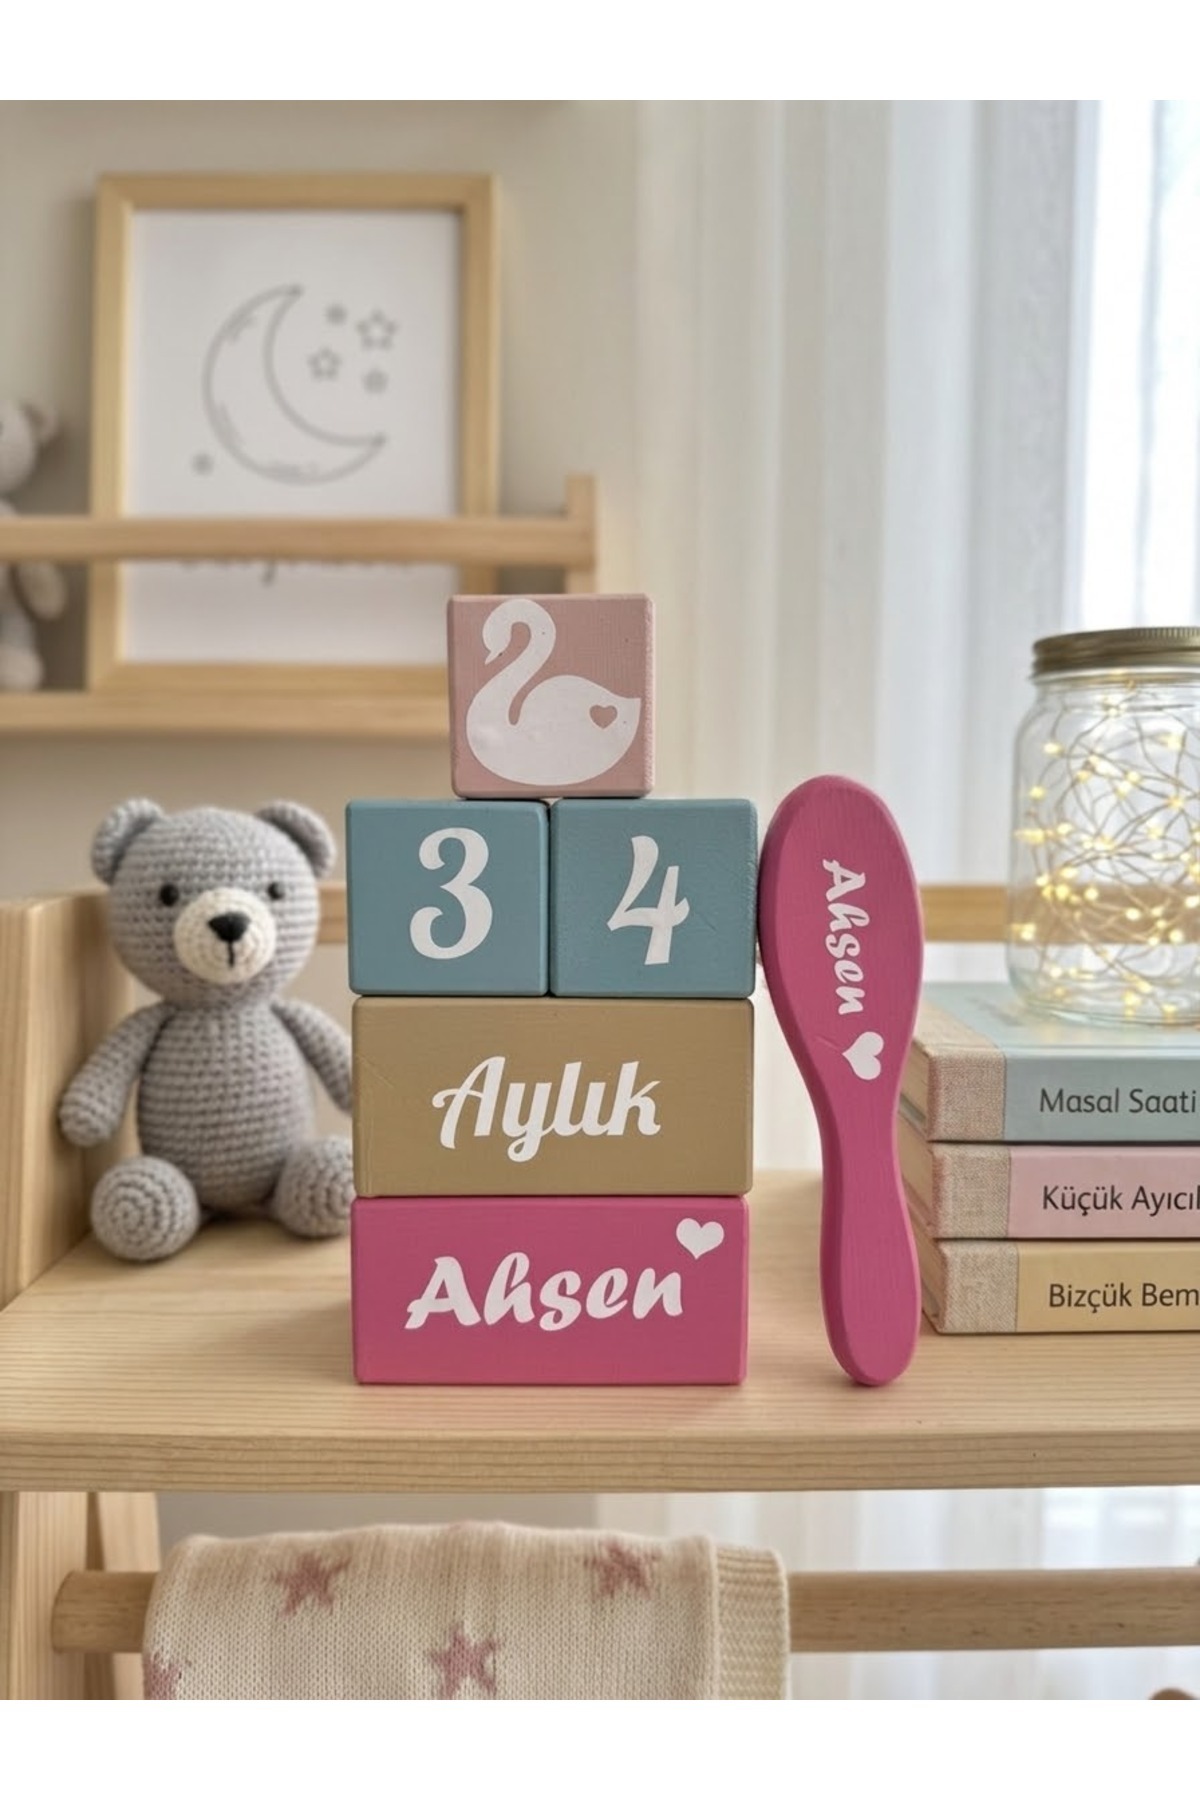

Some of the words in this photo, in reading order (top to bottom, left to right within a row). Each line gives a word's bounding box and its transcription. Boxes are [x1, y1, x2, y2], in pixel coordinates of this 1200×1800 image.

[409, 827, 493, 960] 3
[607, 835, 690, 965] 4
[822, 858, 870, 1015] Ahsen
[432, 1056, 661, 1163] Aylık
[1039, 1087, 1120, 1114] Masal
[1128, 1088, 1198, 1114] Saati
[1043, 1185, 1123, 1218] Küçük
[405, 1252, 683, 1331] Ahsen
[1049, 1283, 1133, 1315] Bizçük
[1141, 1283, 1200, 1307] Bem
